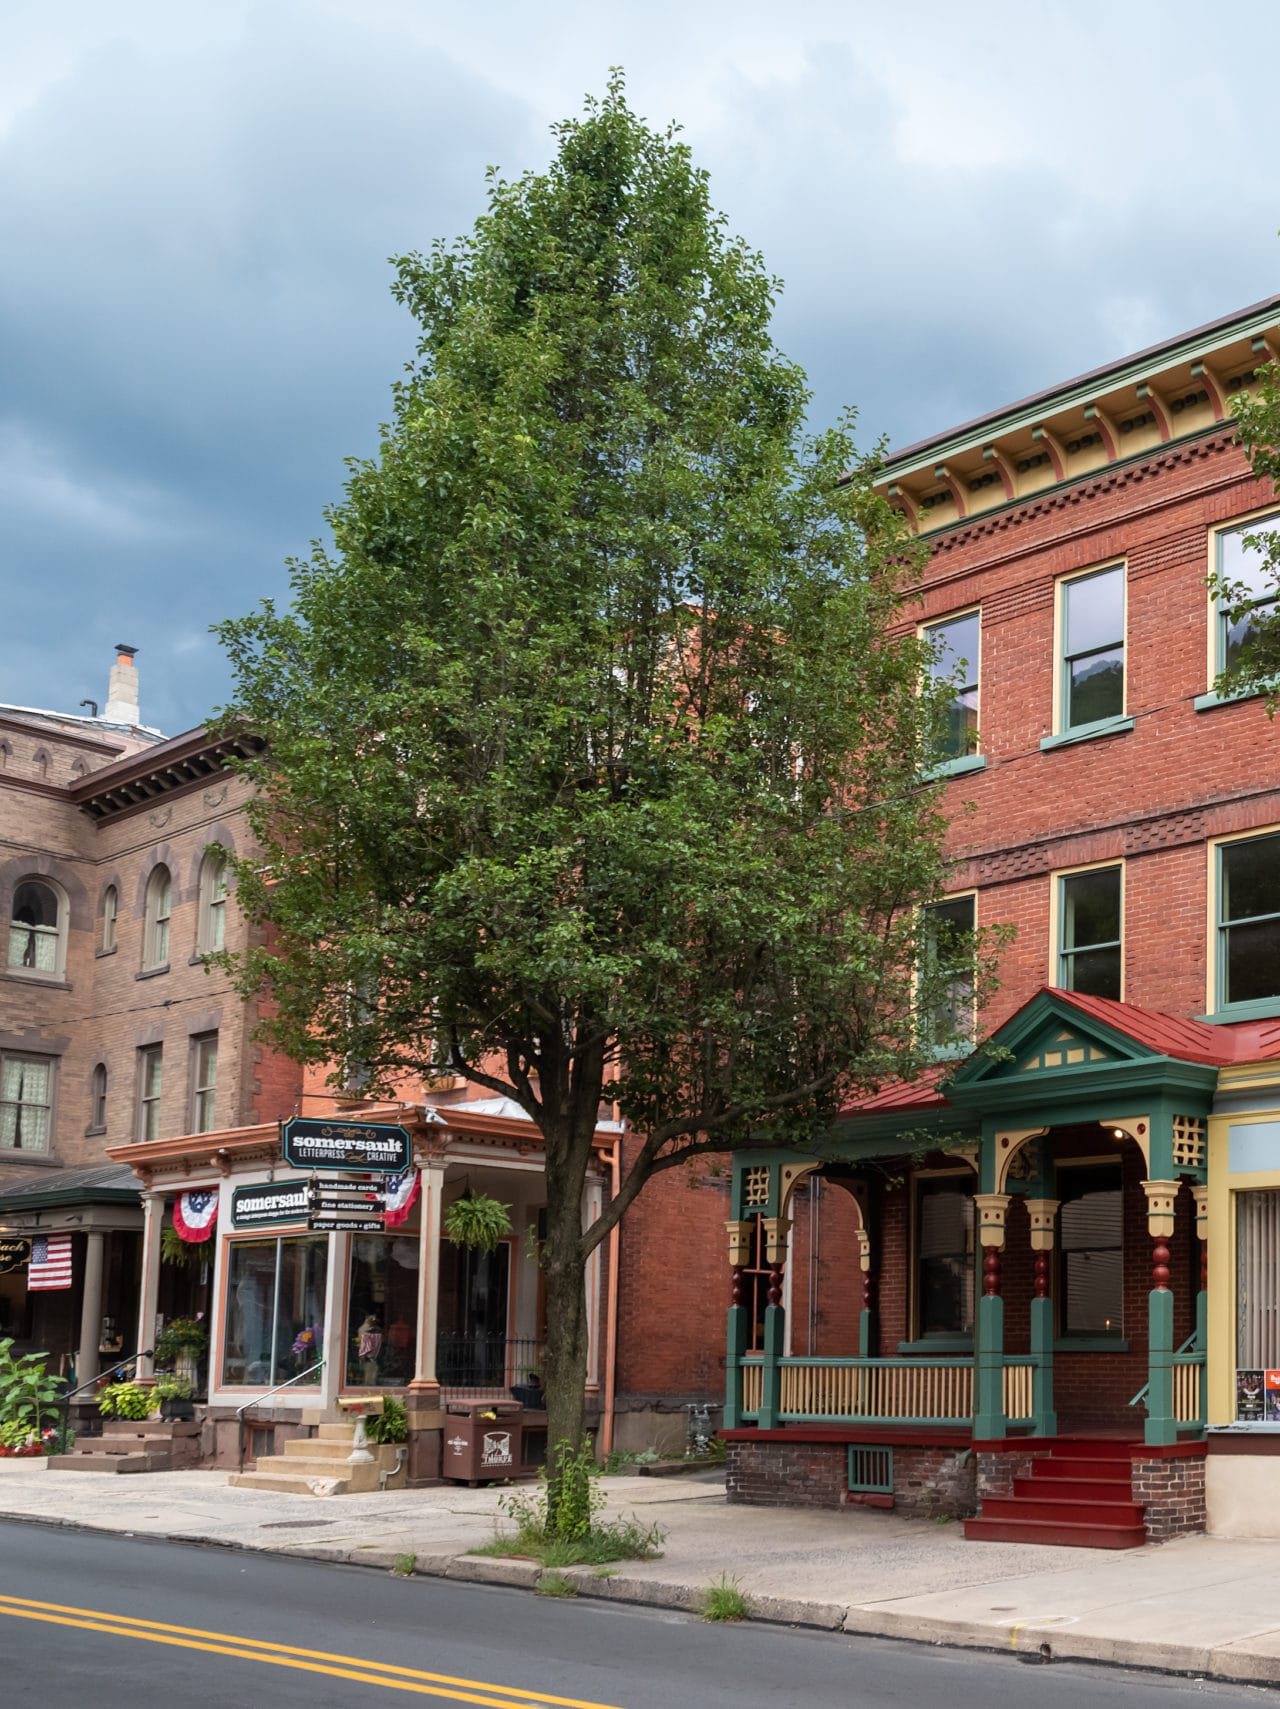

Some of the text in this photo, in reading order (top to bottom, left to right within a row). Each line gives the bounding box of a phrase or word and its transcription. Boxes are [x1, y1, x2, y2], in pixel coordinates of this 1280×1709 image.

[292, 1136, 403, 1153] somersault
[299, 1148, 346, 1160] LETTERPRESS
[366, 1152, 397, 1162] CREATIVE
[318, 1182, 378, 1192] handmade cards
[321, 1201, 375, 1211] fine stationery
[313, 1222, 381, 1231] paper goods gifts
